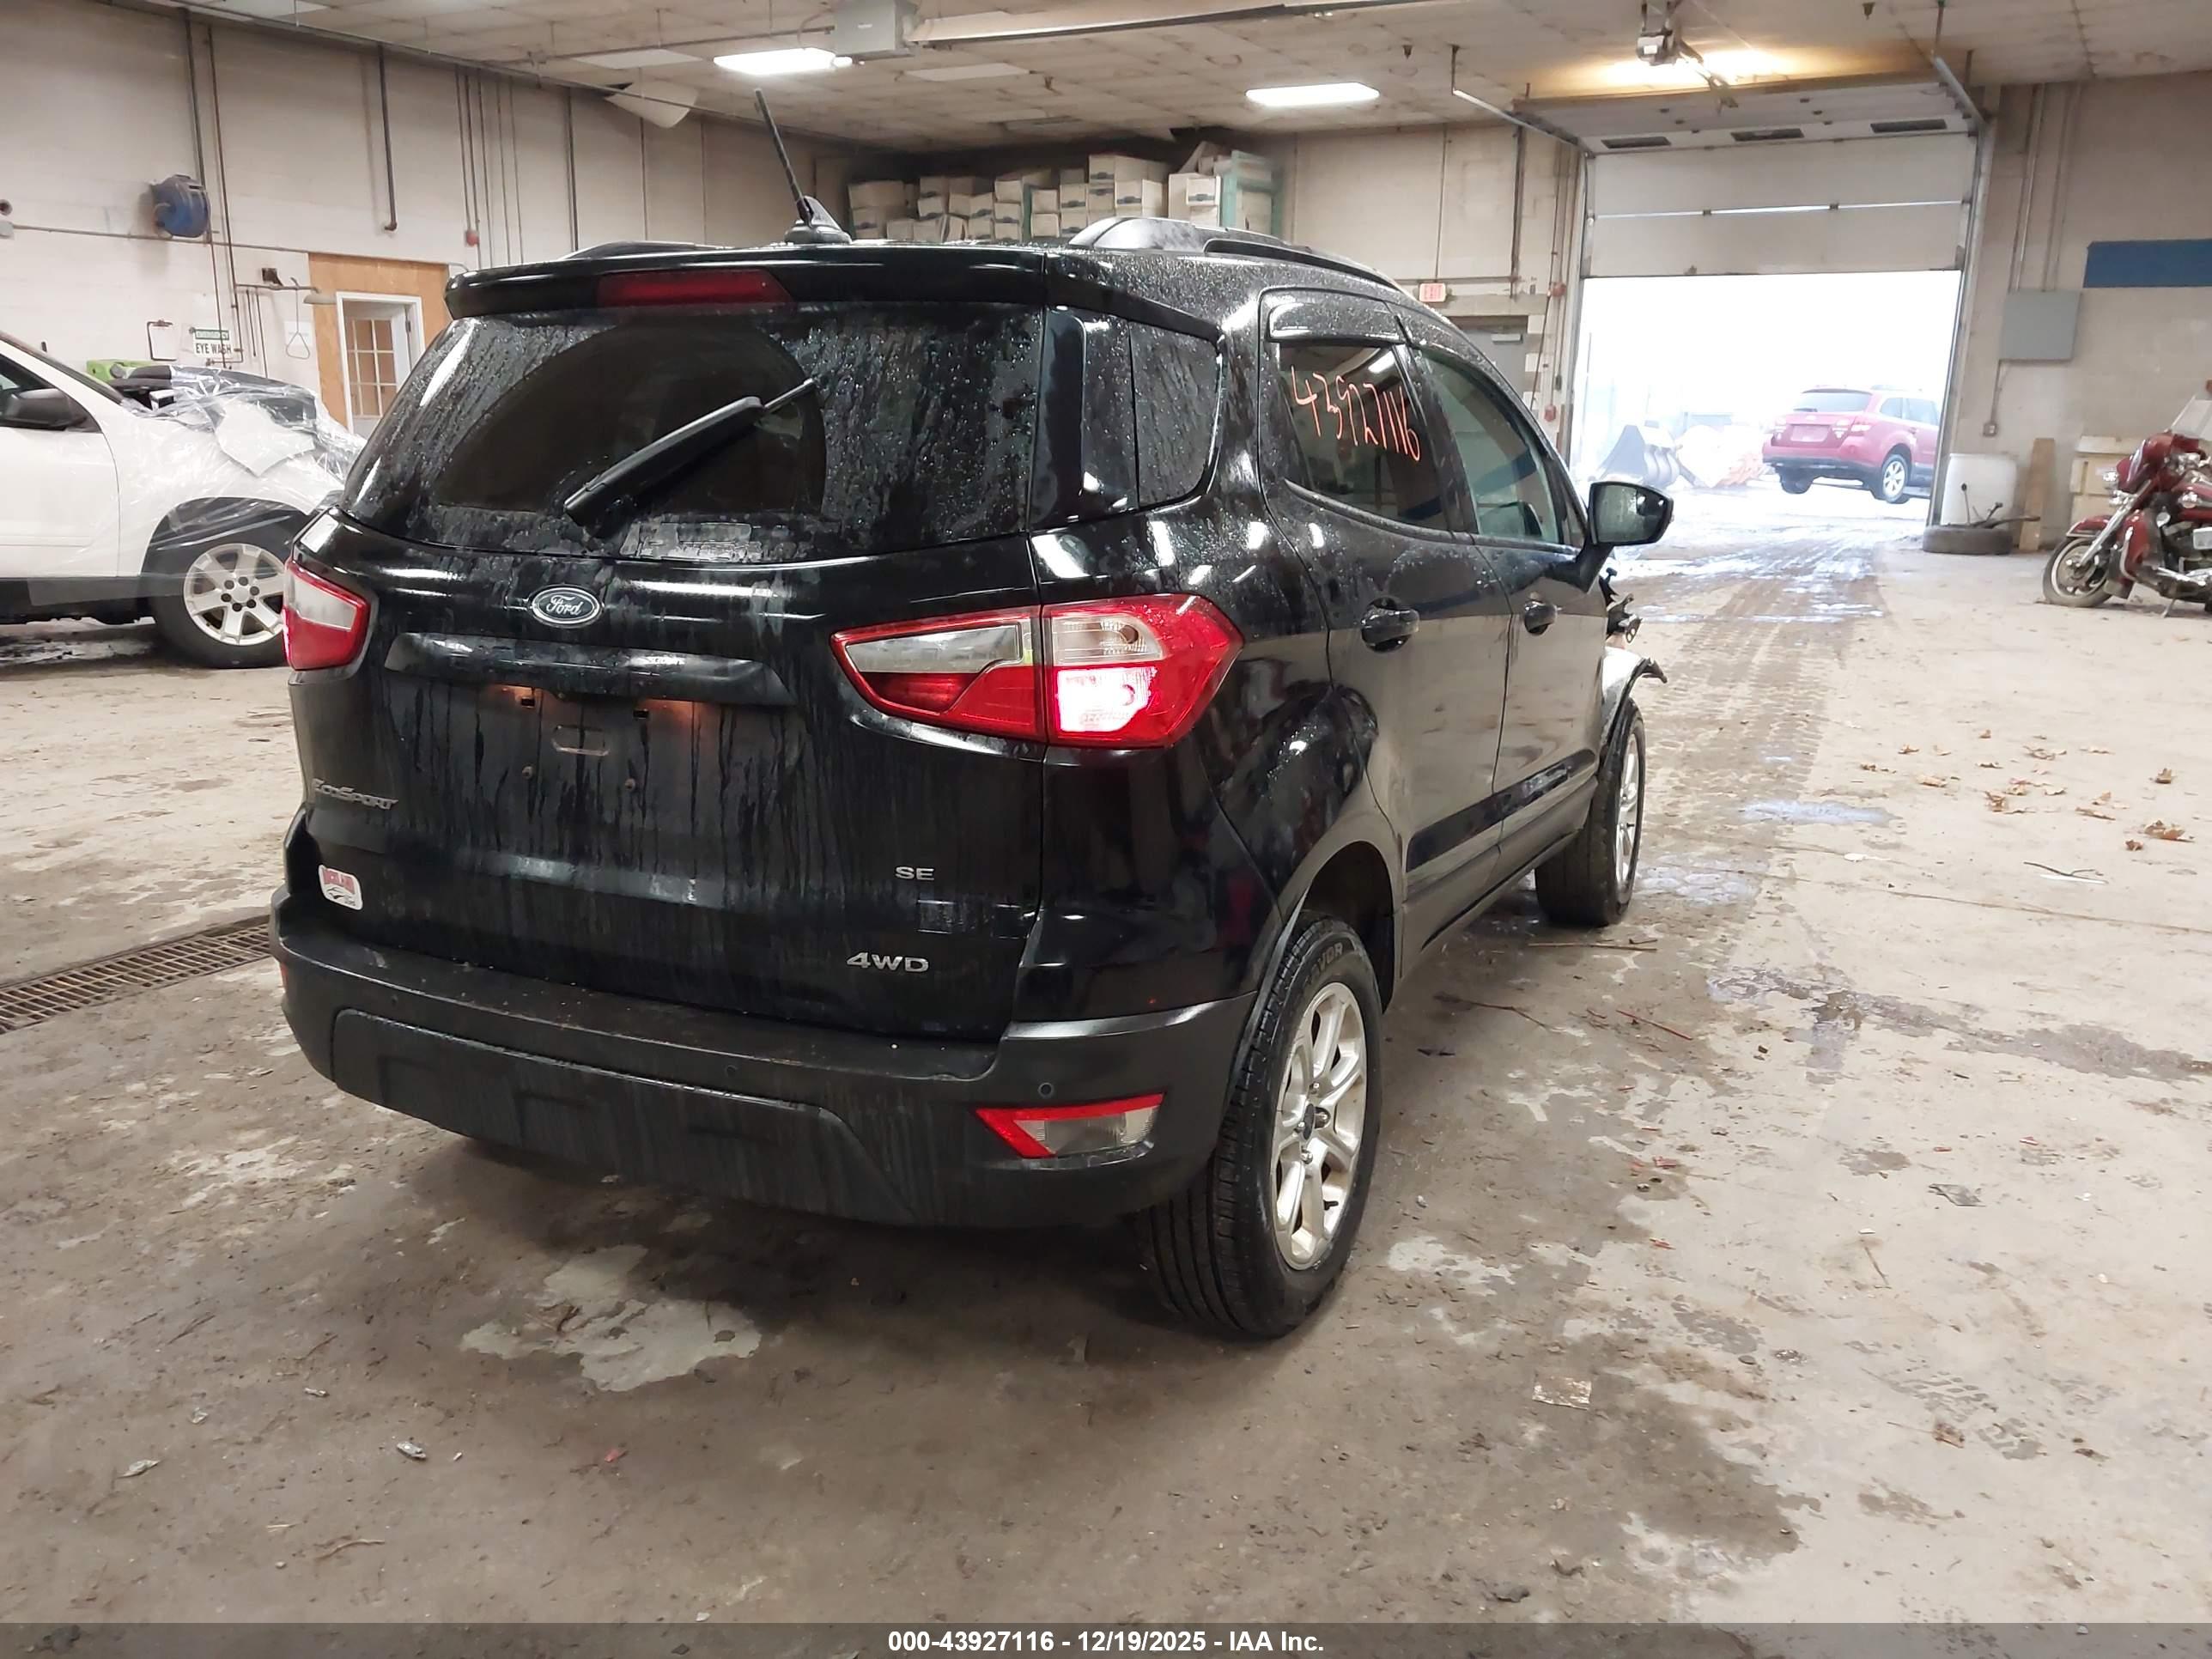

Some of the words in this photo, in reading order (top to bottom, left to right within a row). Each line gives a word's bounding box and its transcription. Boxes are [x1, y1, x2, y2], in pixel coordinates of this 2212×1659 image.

[196, 343, 210, 354] EYE
[210, 343, 232, 354] WASH
[1291, 365, 1420, 461] 43927116
[546, 594, 584, 615] Ford
[895, 866, 934, 880] SE
[847, 952, 929, 972] 4WD
